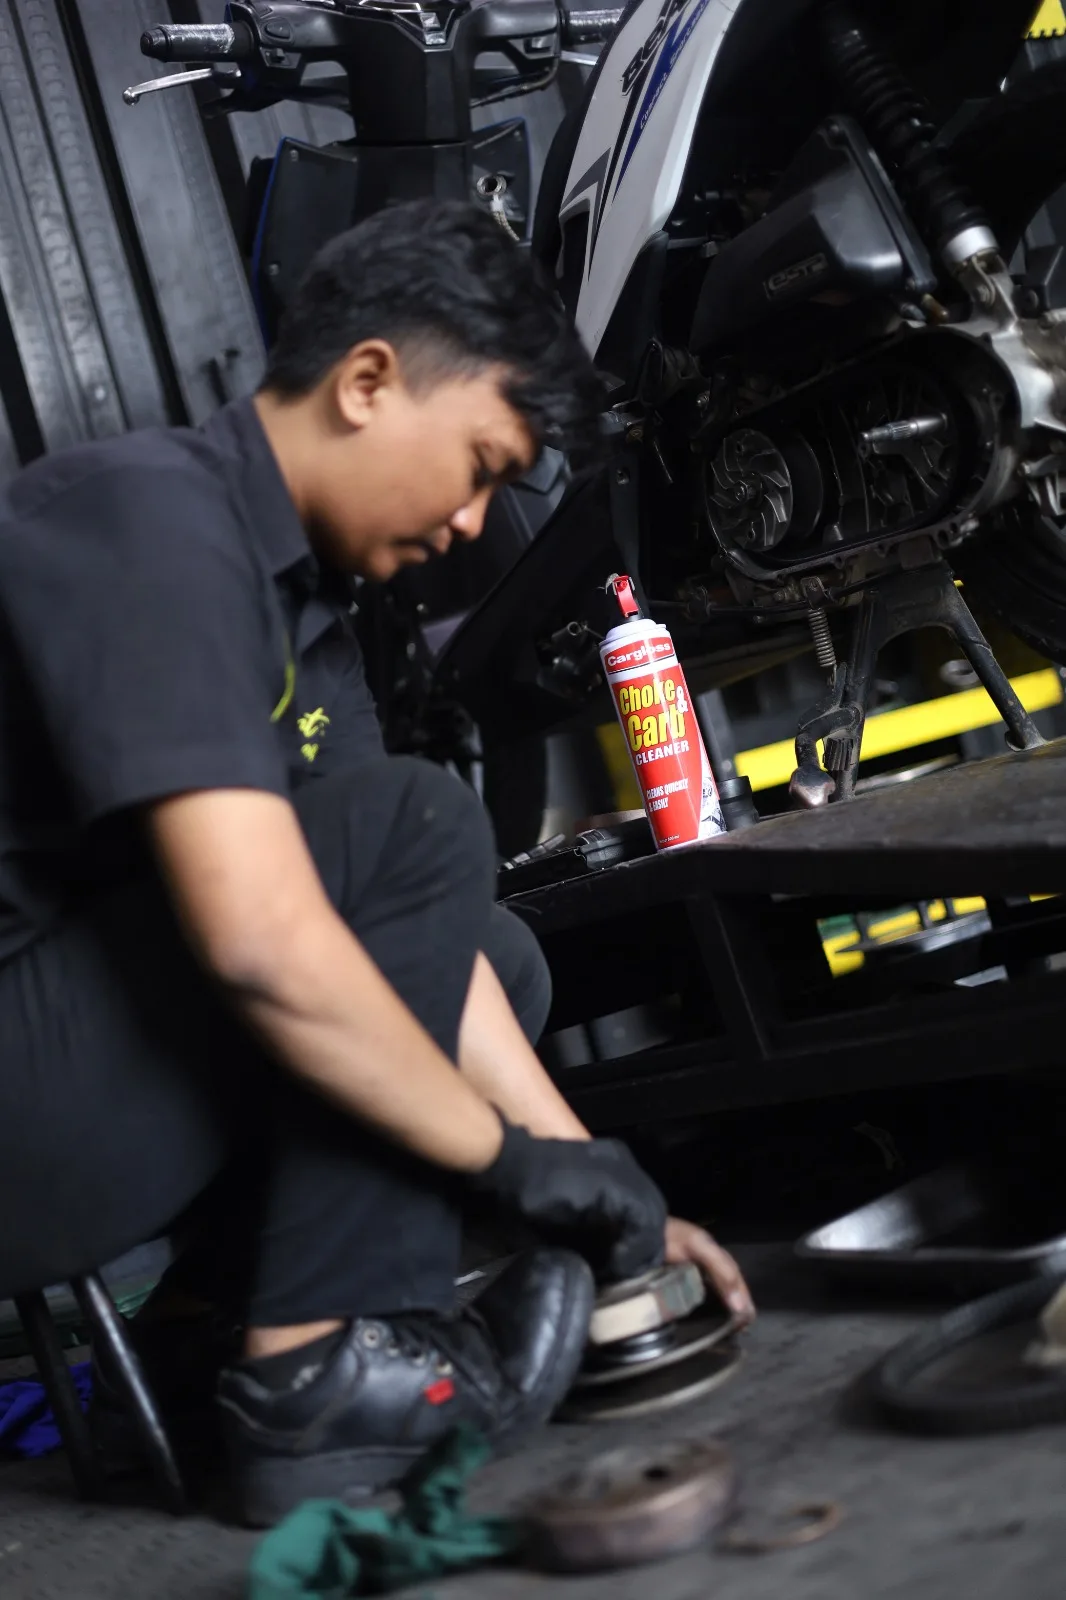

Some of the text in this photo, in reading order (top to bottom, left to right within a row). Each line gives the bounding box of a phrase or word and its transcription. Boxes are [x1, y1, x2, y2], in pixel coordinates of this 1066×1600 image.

[607, 643, 671, 667] Cargloss
[620, 679, 688, 715] Choke &
[628, 704, 686, 751] Carb
[635, 740, 690, 765] CLEANER
[664, 778, 688, 795] QUICKLY
